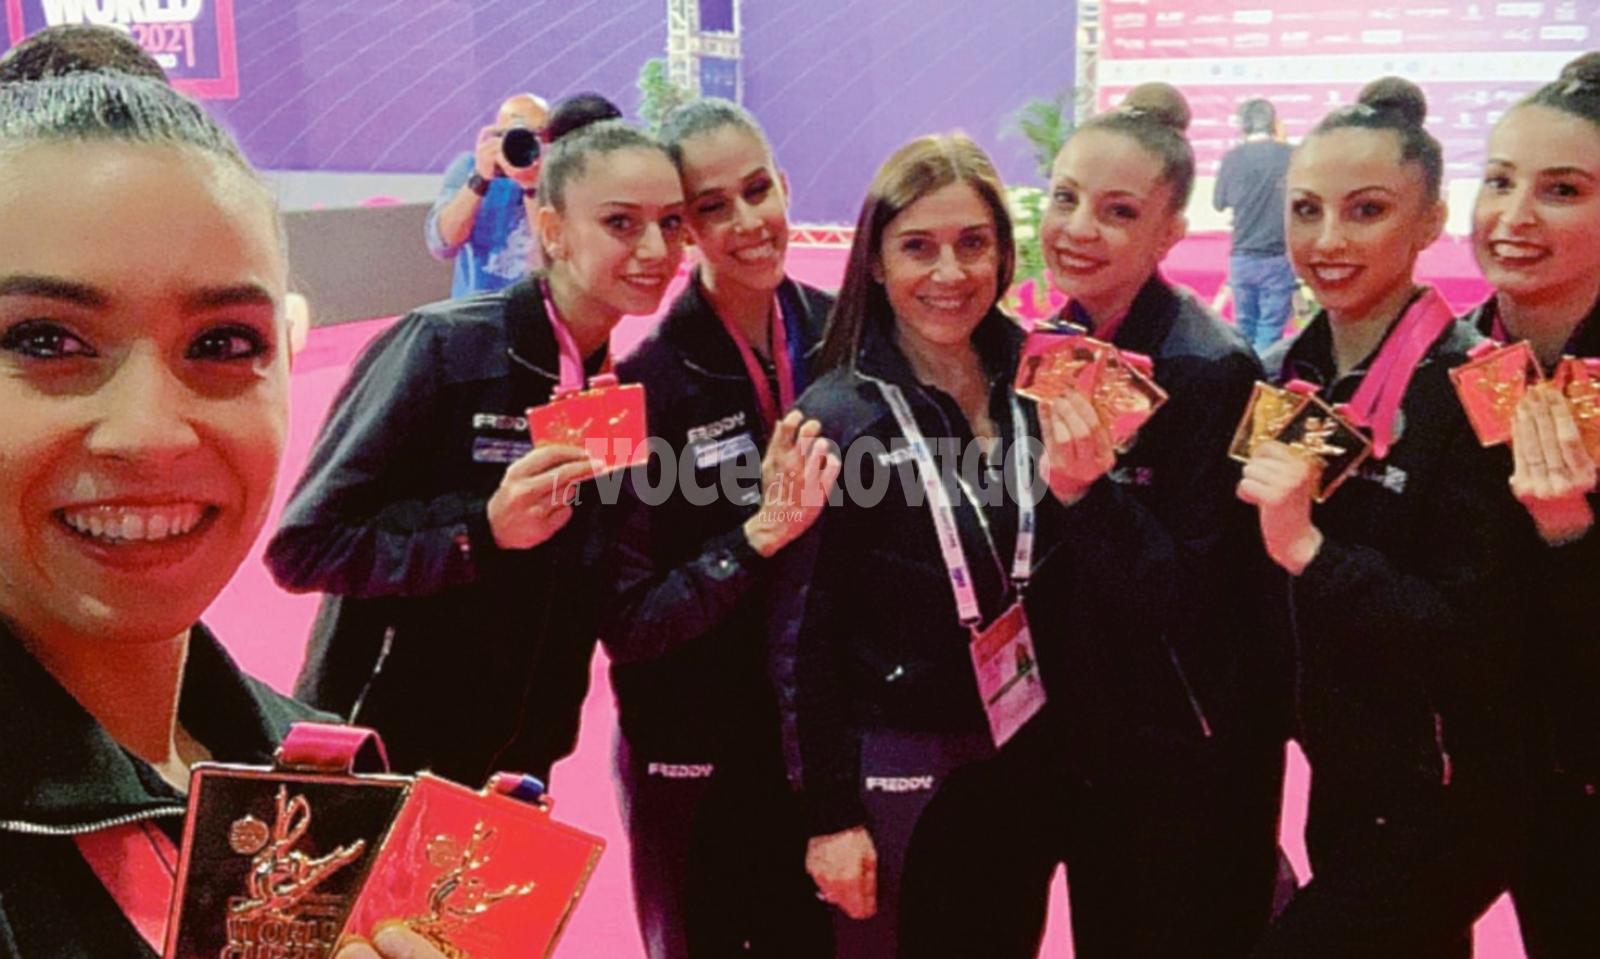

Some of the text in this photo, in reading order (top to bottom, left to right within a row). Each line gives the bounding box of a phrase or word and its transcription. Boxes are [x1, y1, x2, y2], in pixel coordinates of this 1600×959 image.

[132, 23, 196, 67] 2021
[473, 413, 528, 431] FREDD
[648, 762, 713, 778] FREDDY
[866, 775, 934, 792] FREDDY
